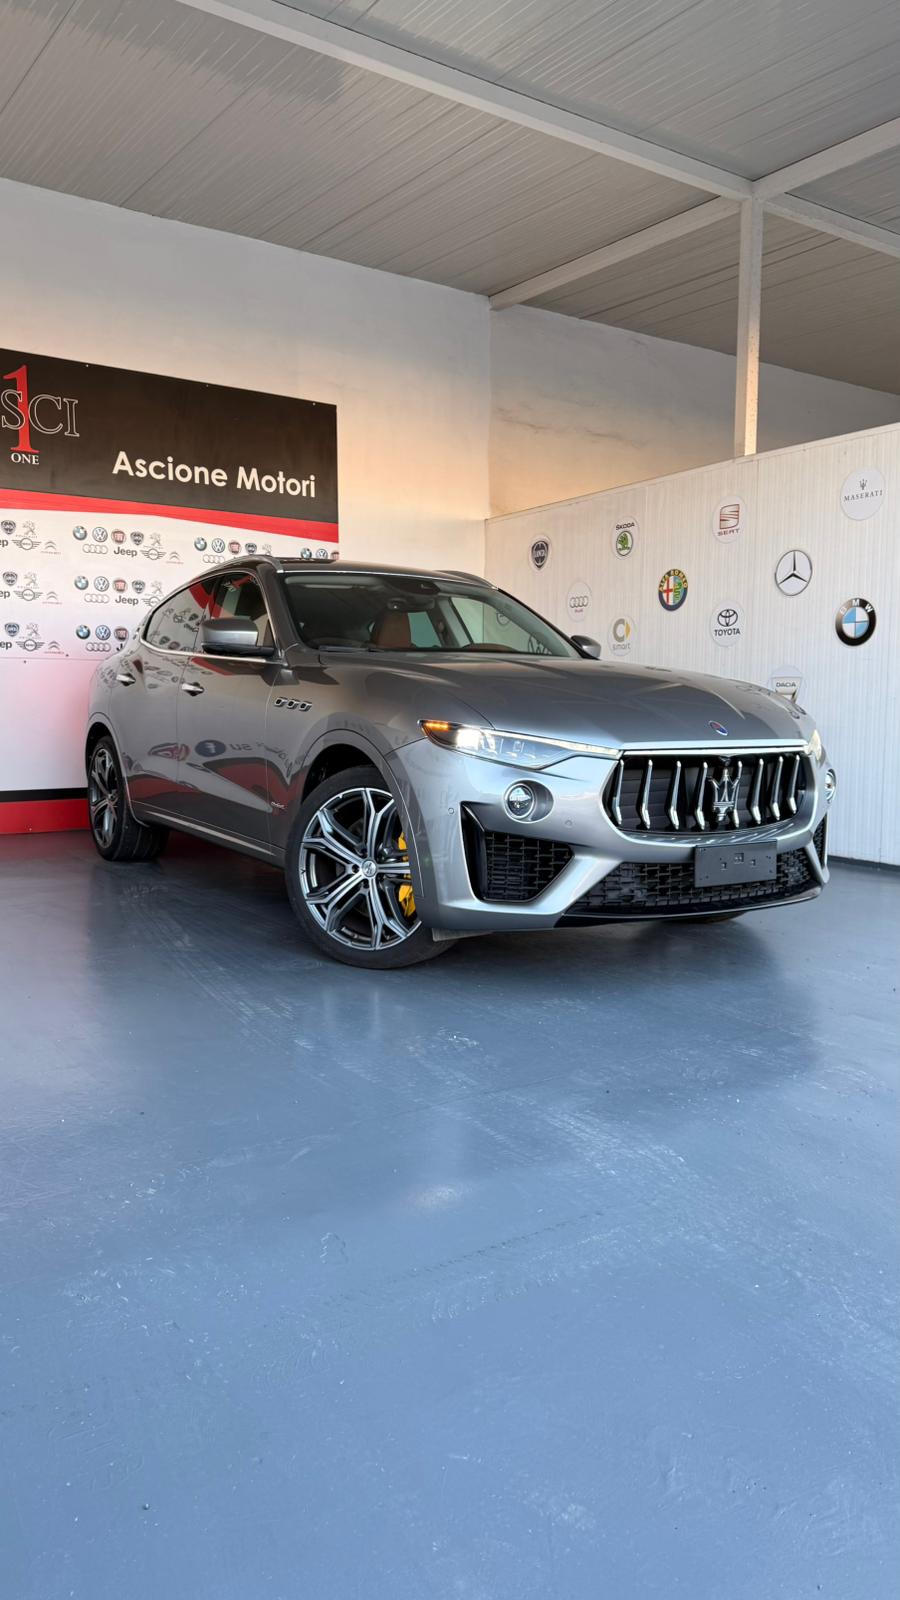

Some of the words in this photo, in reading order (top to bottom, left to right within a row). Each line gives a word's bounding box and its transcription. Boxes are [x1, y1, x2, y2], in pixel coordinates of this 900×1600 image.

[11, 452, 40, 465] ONE
[112, 450, 228, 487] Ascione
[236, 466, 316, 498] Motori
[843, 490, 883, 502] MASERATI
[113, 546, 138, 558] Jeep
[115, 595, 139, 606] Jeep
[840, 598, 874, 614] BMW
[714, 628, 741, 637] TOYOTA
[612, 643, 631, 651] smart
